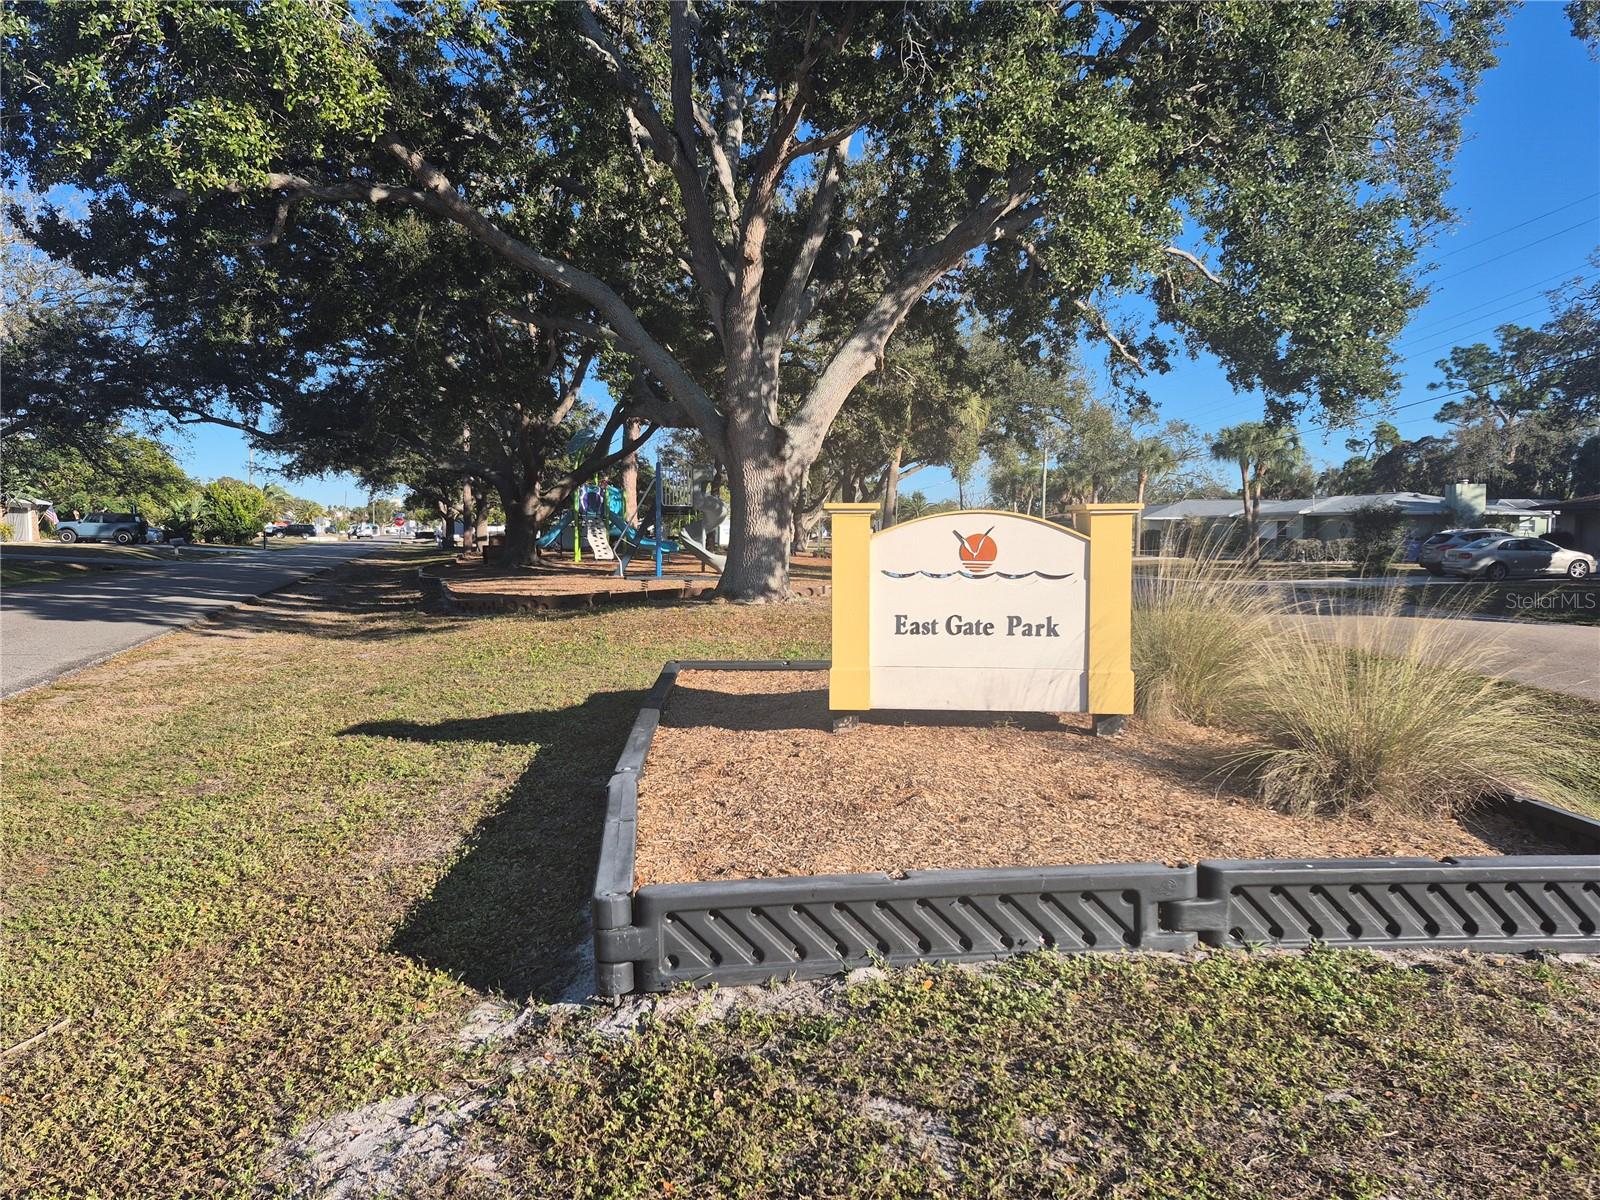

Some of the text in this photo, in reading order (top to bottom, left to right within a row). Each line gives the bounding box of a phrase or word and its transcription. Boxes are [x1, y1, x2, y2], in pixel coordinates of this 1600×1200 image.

[894, 614, 1060, 637] East Gate Park
